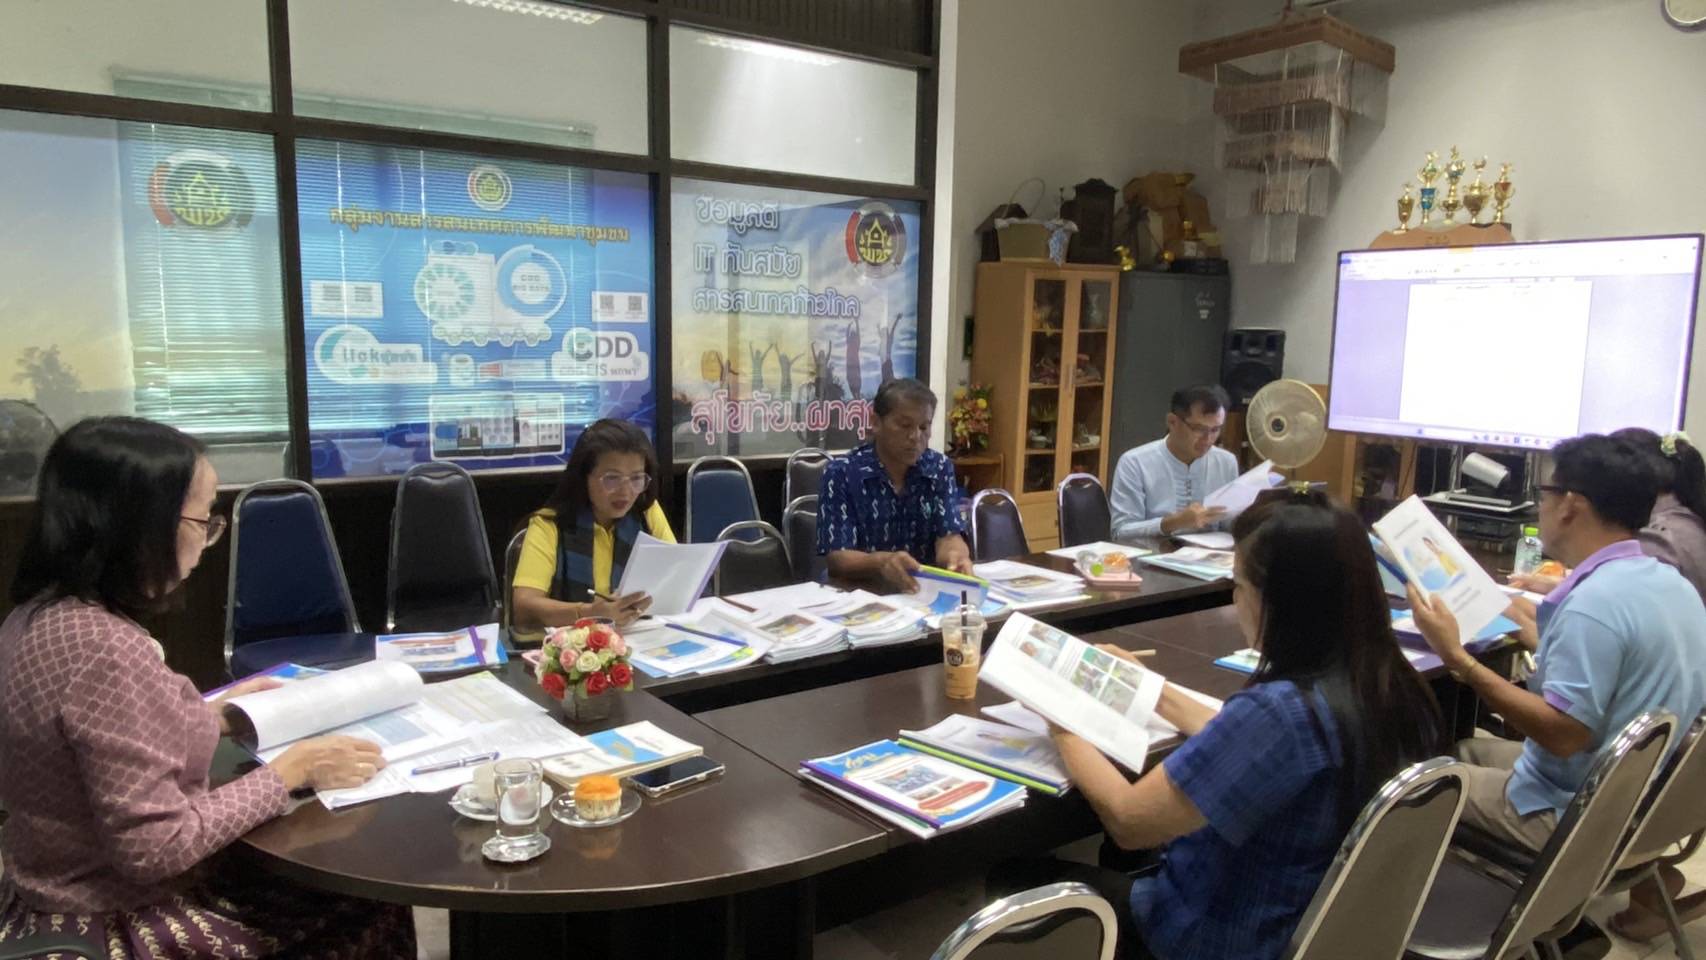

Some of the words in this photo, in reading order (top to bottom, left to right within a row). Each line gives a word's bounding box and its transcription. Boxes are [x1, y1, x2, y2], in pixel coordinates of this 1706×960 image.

[696, 194, 779, 234] ข้อมูลดี
[695, 243, 715, 272] IT
[721, 240, 801, 277] ทันสมัย
[693, 285, 861, 317] สารสนเทศก้าวไกล
